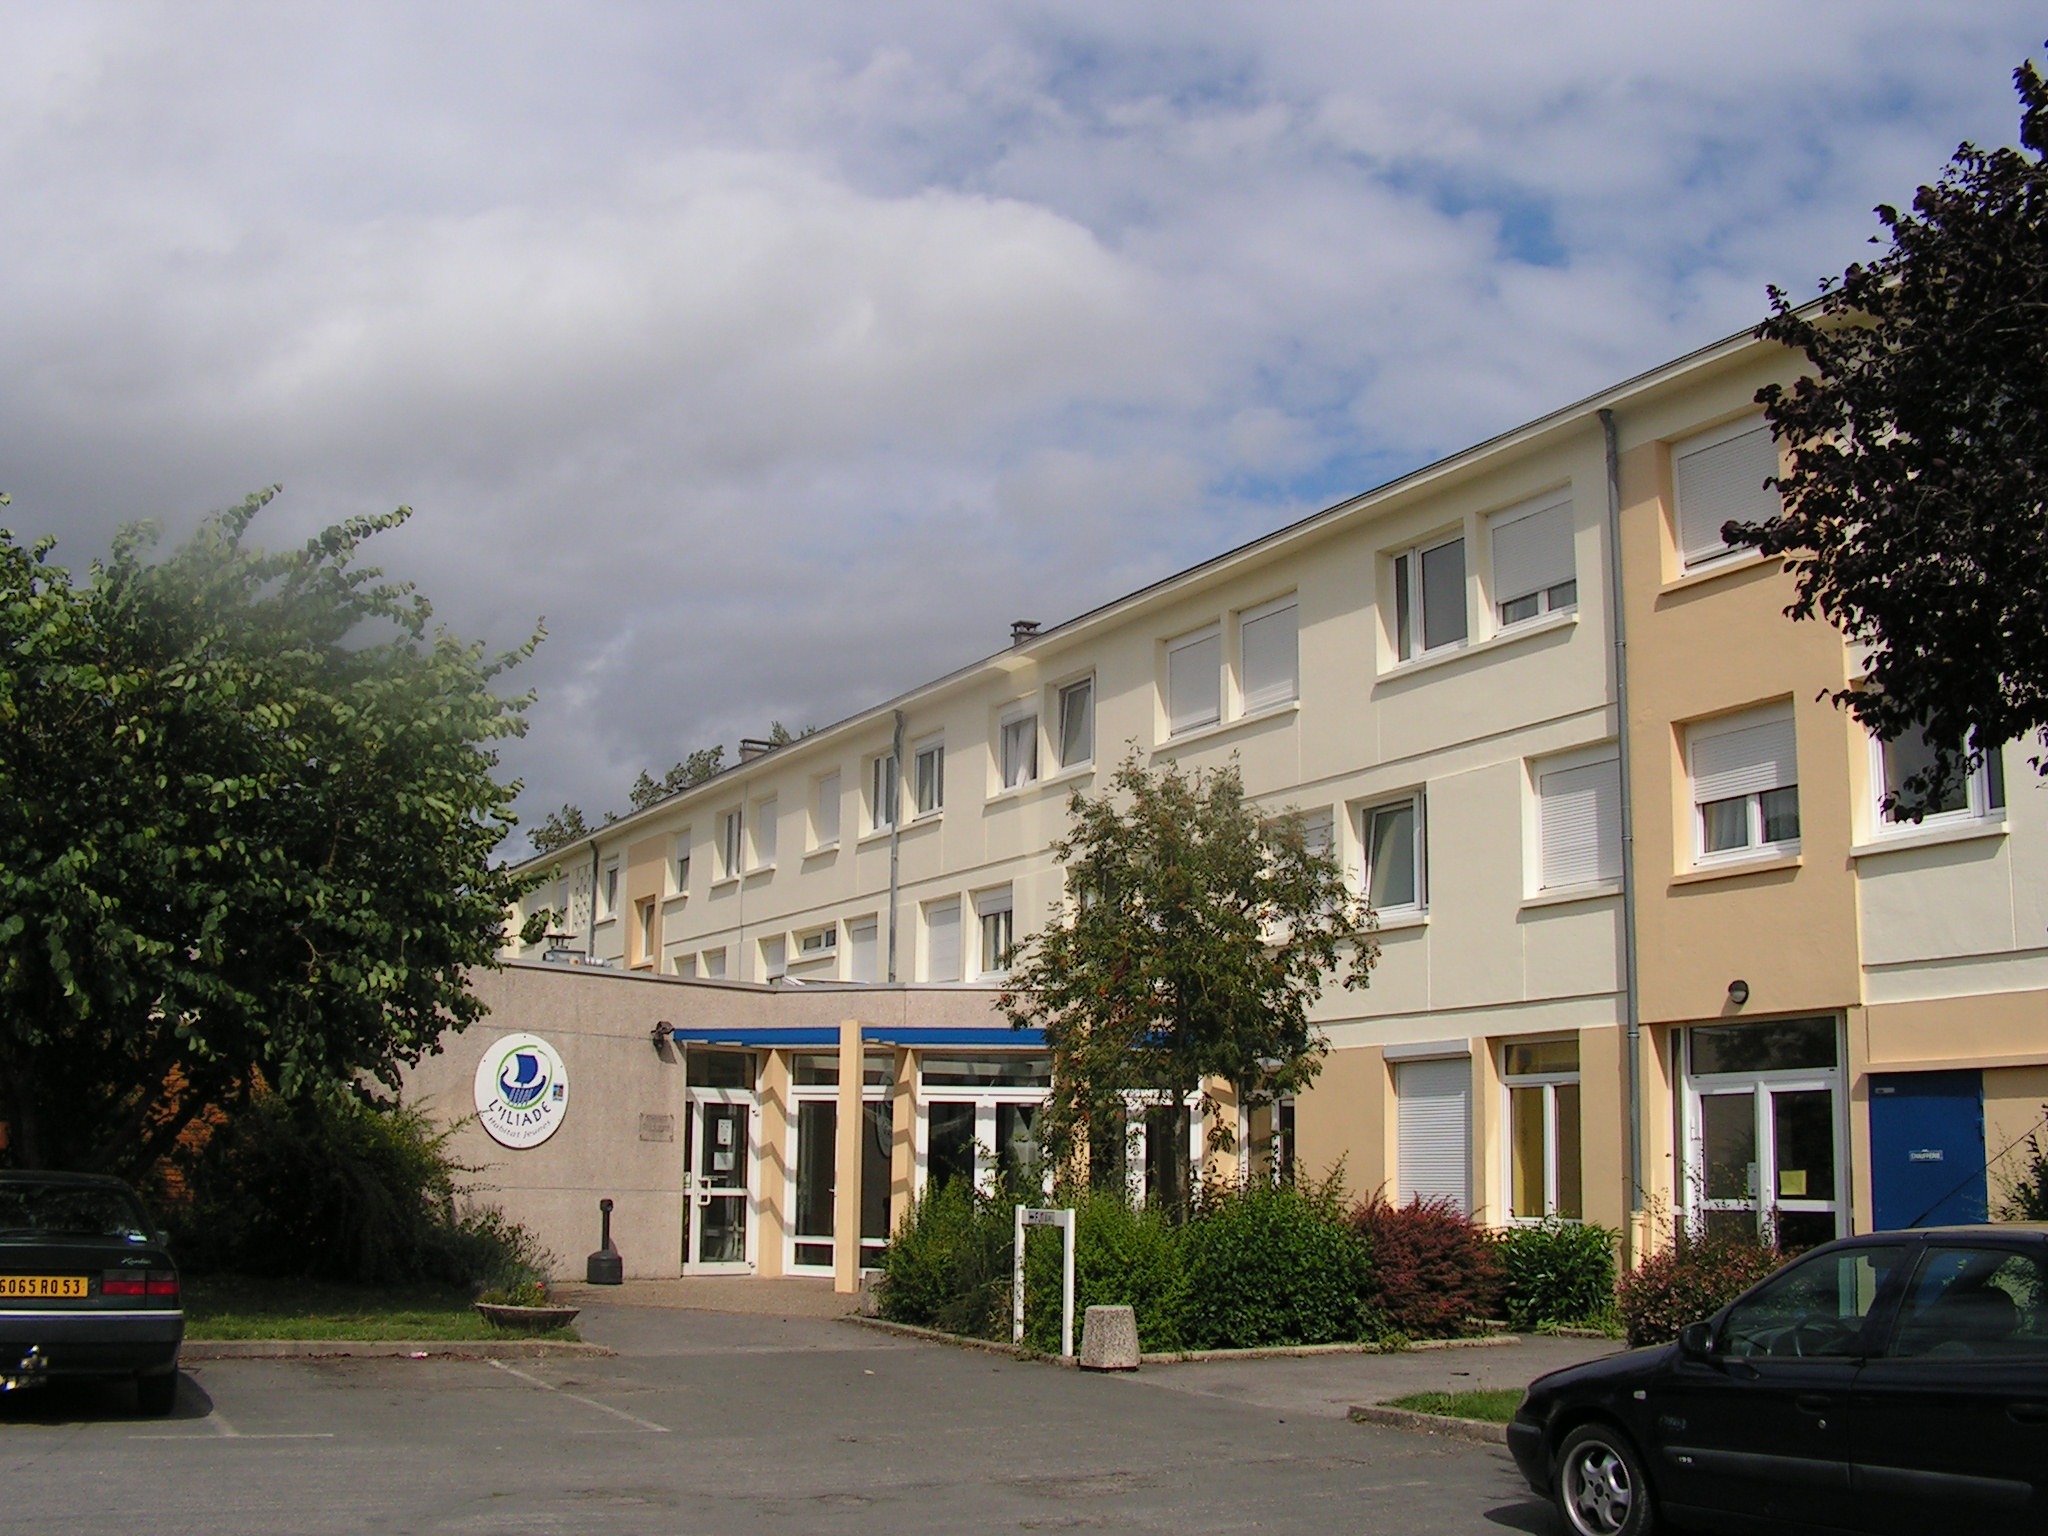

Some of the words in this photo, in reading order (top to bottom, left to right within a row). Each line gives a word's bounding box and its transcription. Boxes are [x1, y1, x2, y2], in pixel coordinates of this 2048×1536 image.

[488, 1099, 552, 1126] L'ILIADE
[489, 1116, 521, 1138] Habitat
[0, 1279, 36, 1294] 6065
[63, 1279, 80, 1295] 53
